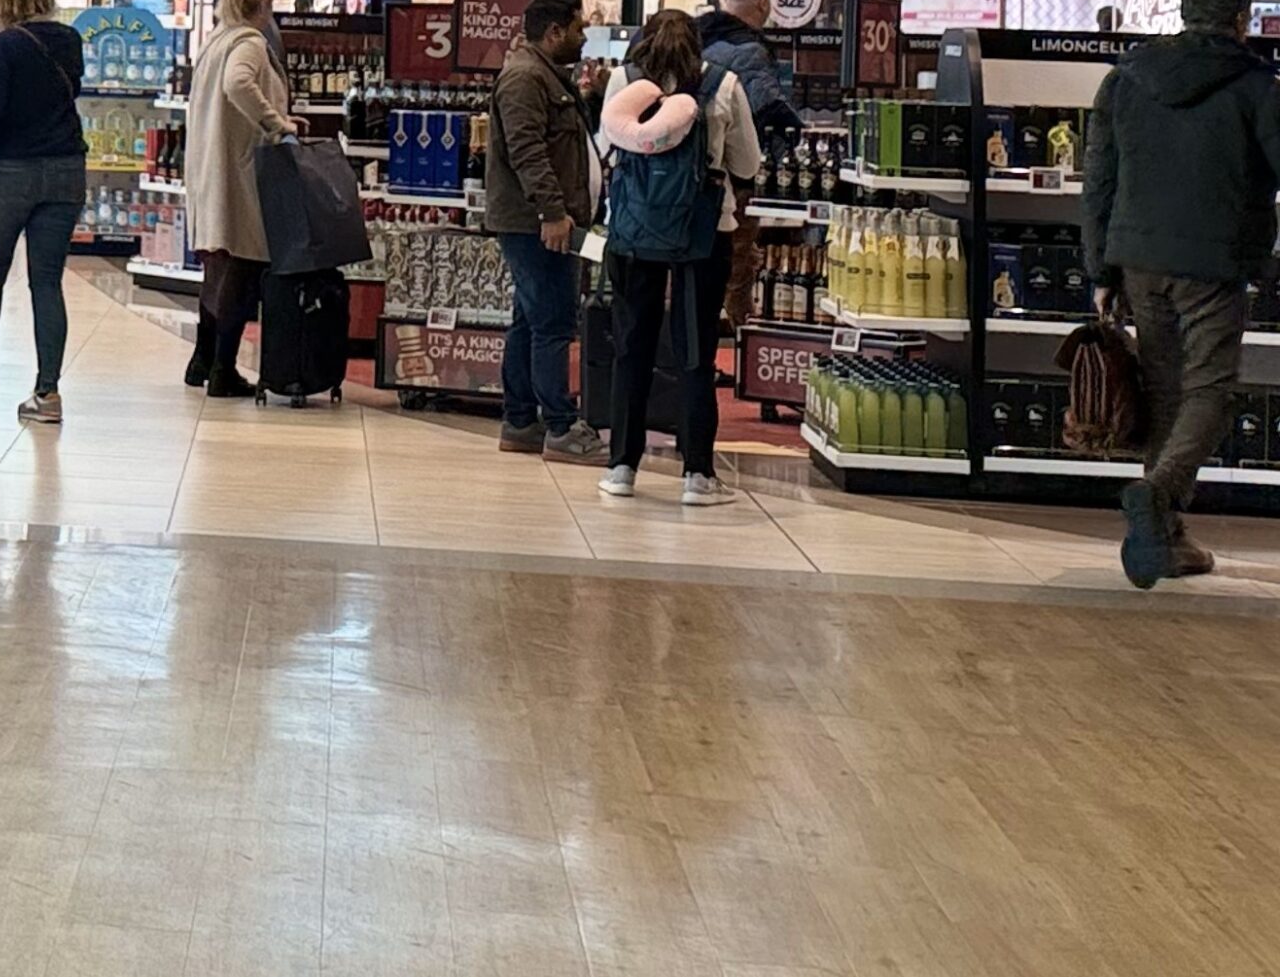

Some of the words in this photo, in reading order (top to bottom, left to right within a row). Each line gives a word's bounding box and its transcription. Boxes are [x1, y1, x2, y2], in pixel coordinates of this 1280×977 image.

[463, 1, 487, 14] IT'S
[489, 3, 501, 14] A
[463, 14, 498, 26] KIND
[500, 16, 521, 27] OF
[462, 27, 511, 40] MAGIC!
[428, 332, 453, 346] IT'S
[456, 335, 467, 347] A
[470, 336, 506, 350] KIND
[428, 346, 450, 358] OF
